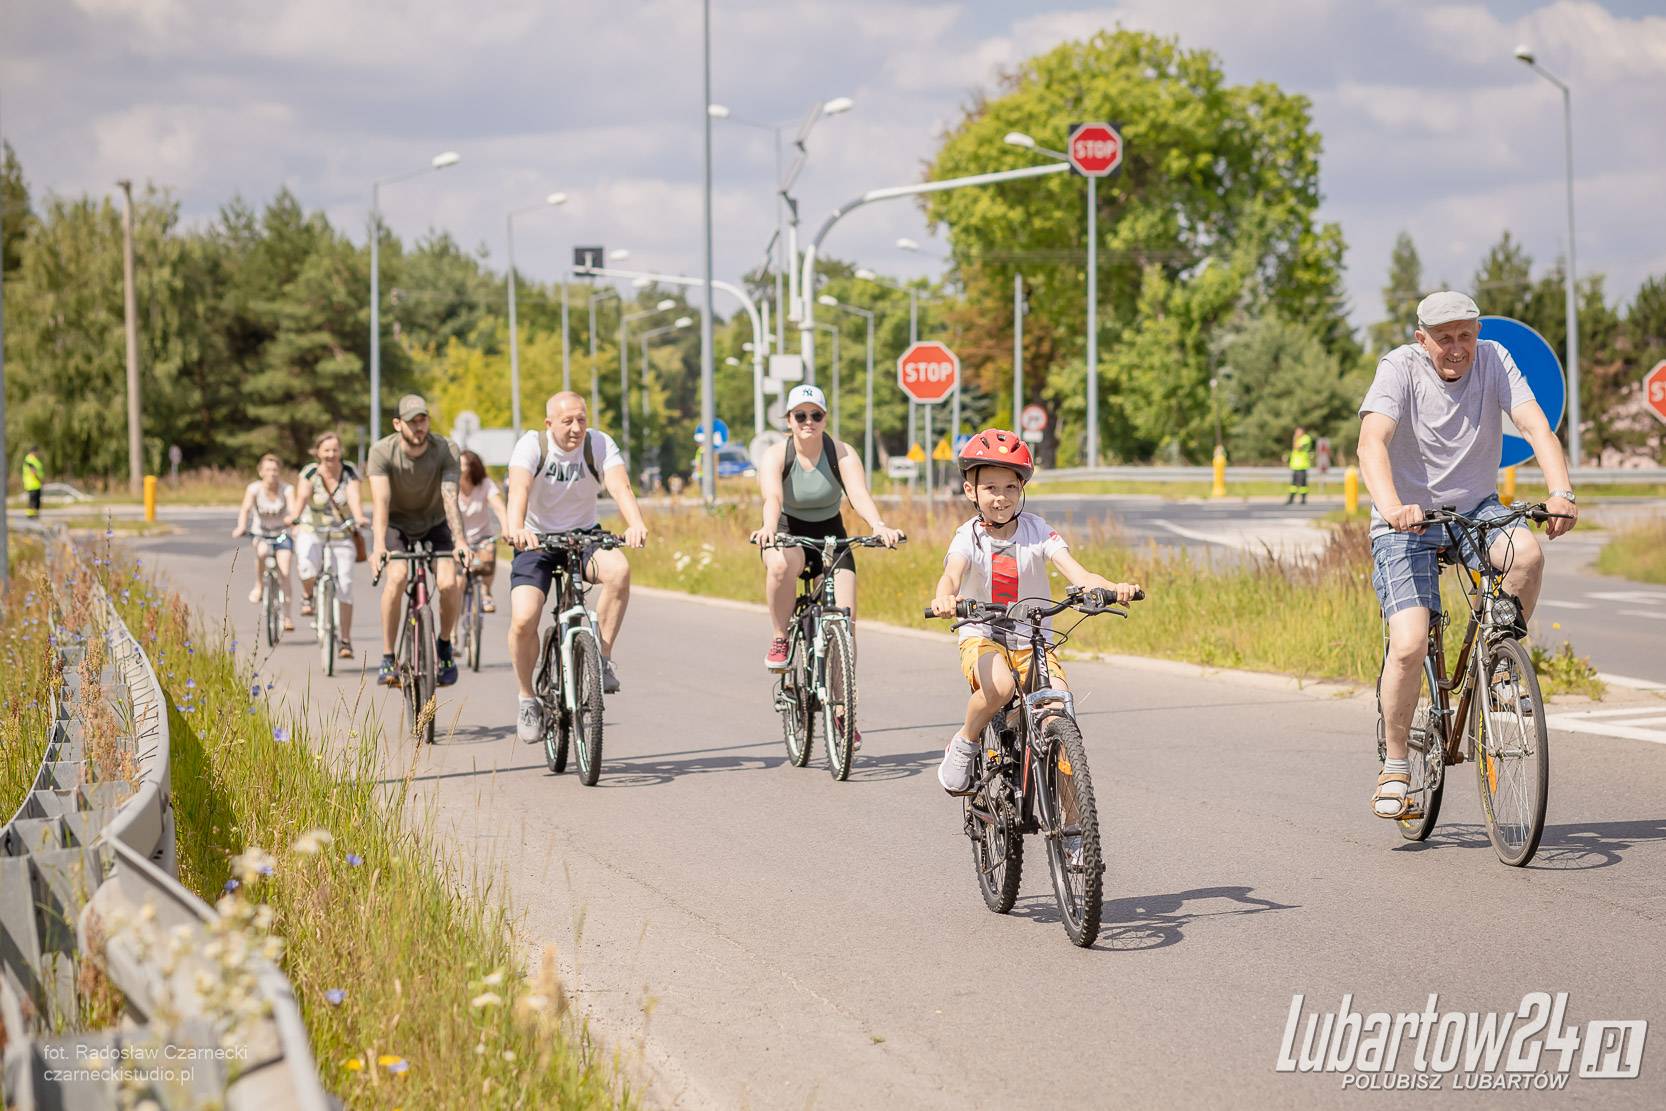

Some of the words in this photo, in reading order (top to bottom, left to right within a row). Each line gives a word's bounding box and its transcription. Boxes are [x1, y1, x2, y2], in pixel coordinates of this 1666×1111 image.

[1075, 140, 1117, 159] STOP
[904, 362, 953, 383] STOP
[1651, 381, 1666, 402] S
